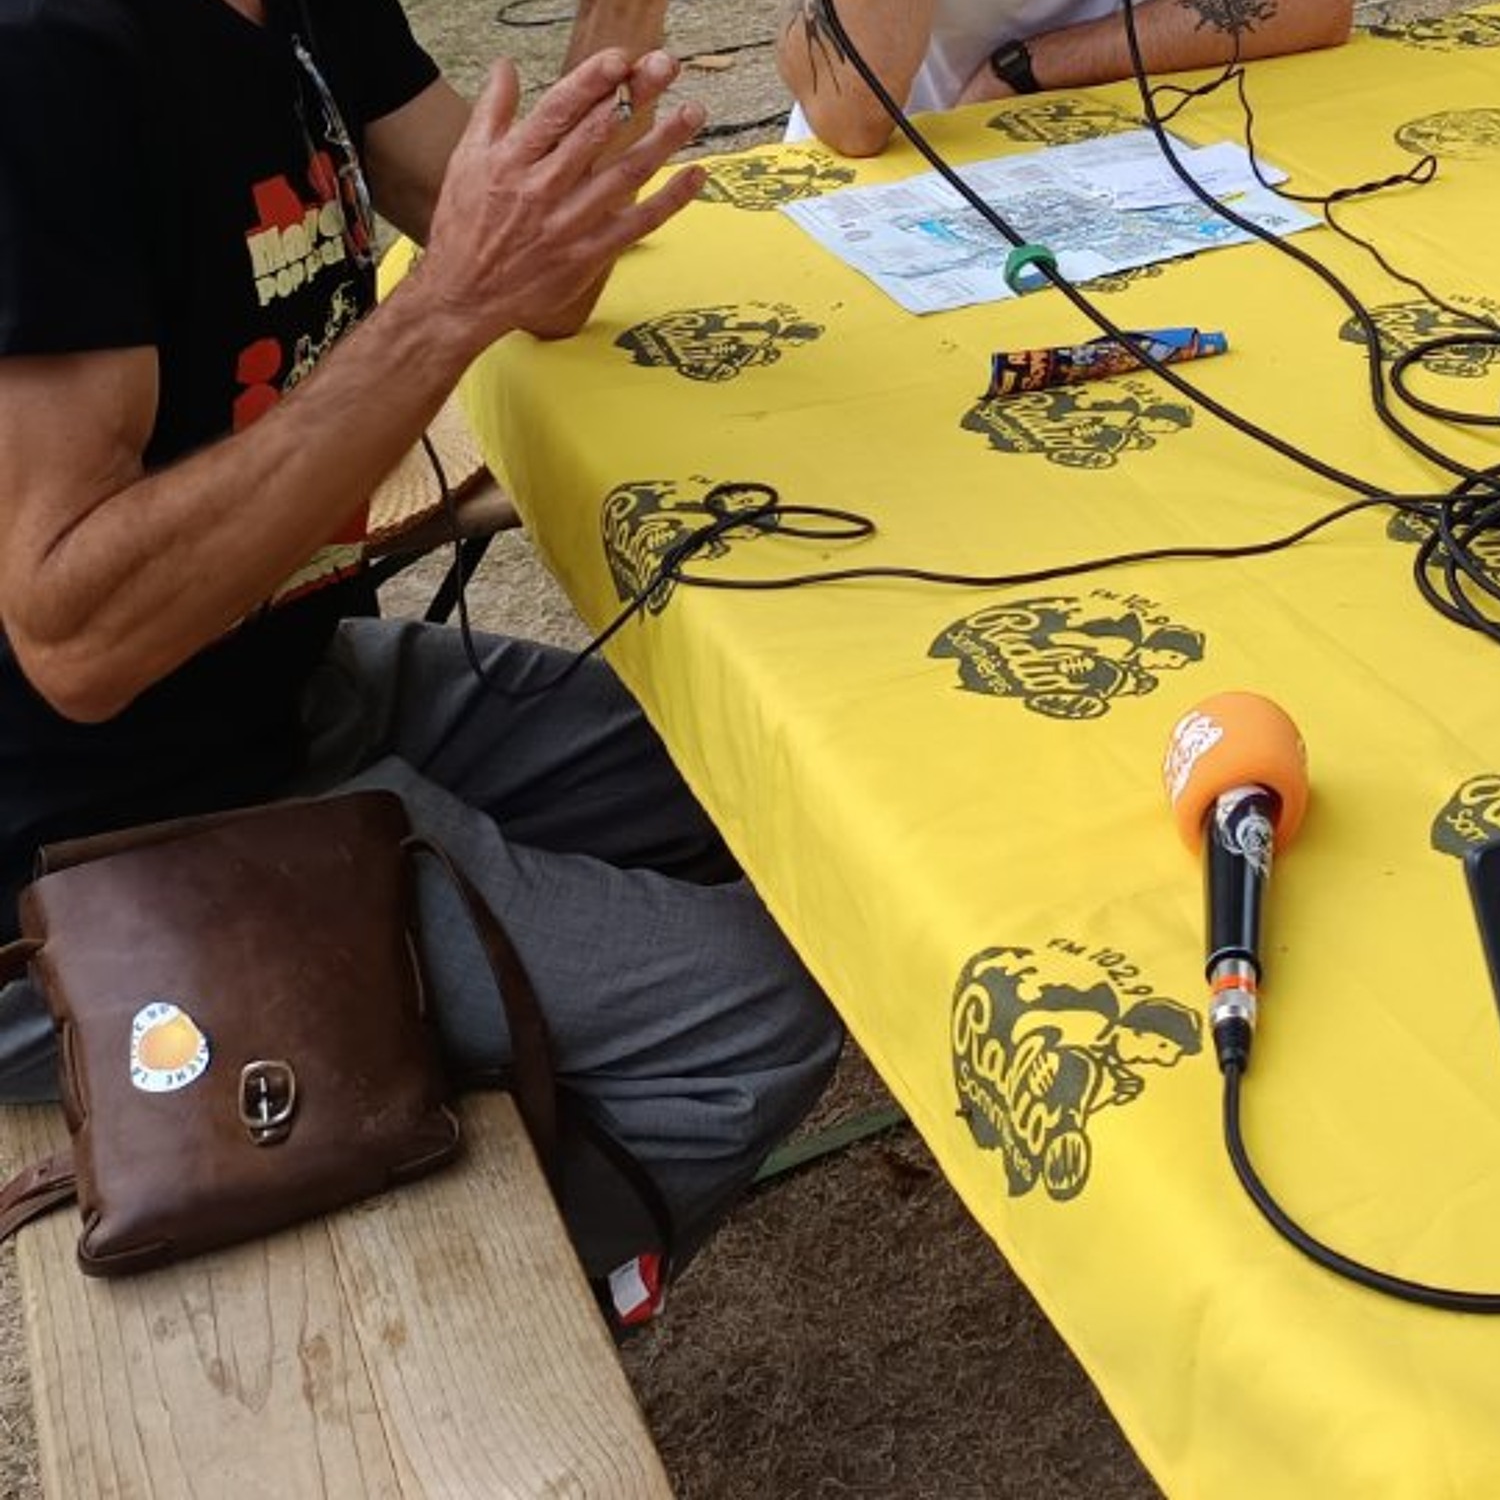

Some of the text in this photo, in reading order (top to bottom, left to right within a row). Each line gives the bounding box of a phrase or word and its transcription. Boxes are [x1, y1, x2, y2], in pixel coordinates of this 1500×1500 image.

[1046, 937, 1155, 997] FM 102.9
[953, 982, 1062, 1156] Radio
